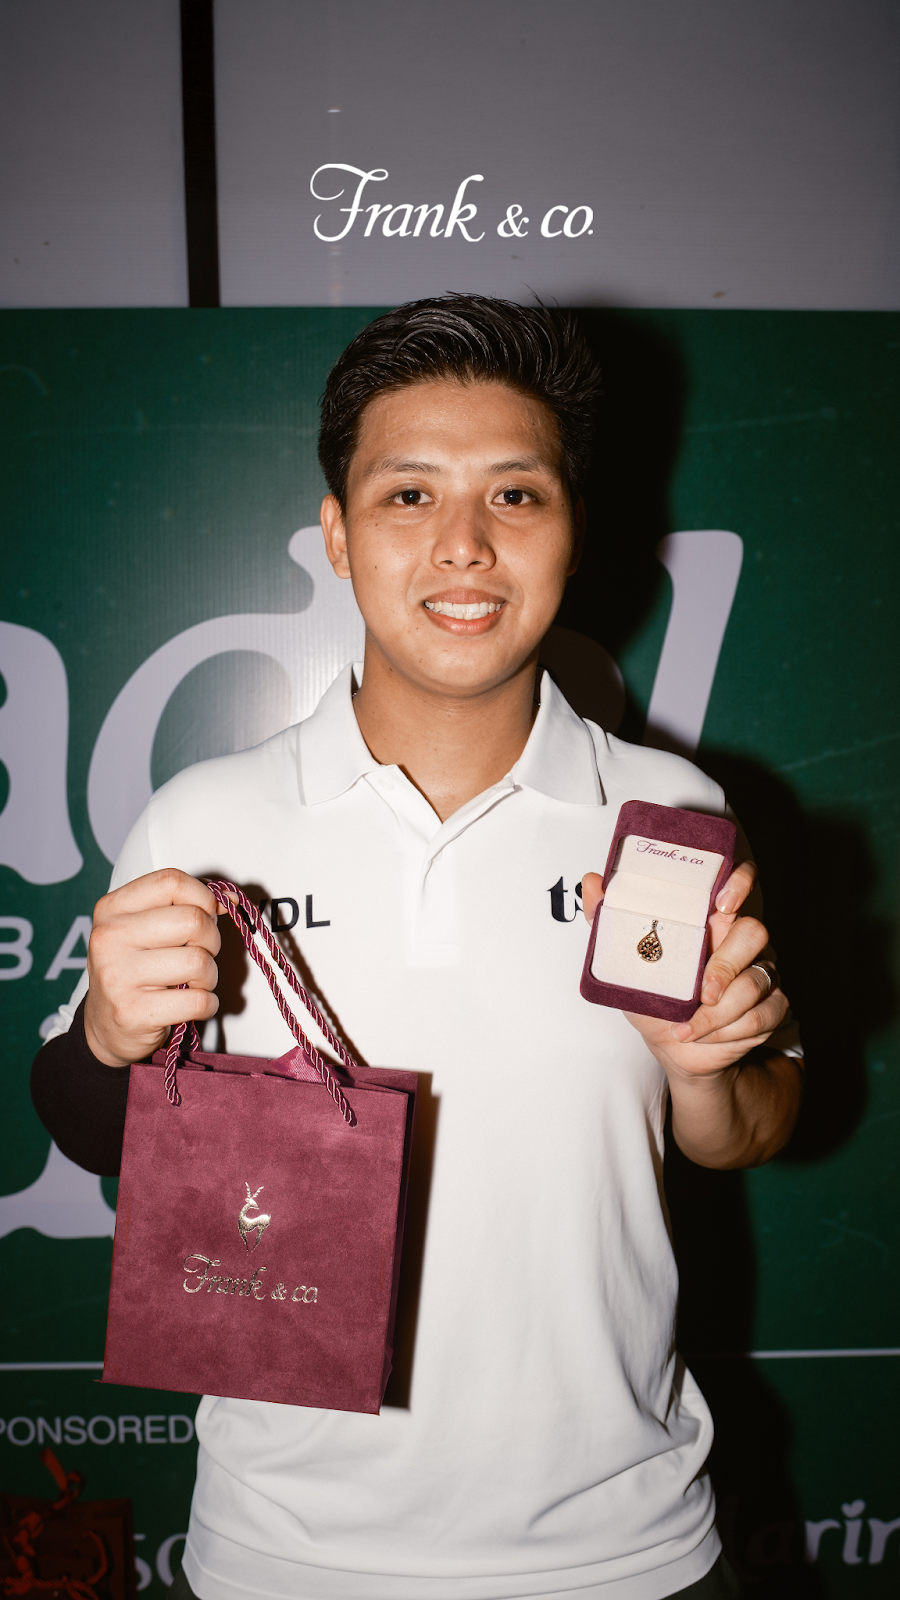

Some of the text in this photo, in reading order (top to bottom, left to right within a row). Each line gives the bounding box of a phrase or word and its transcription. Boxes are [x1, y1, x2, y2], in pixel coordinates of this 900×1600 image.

[636, 840, 680, 860] Frank
[183, 1254, 267, 1300] Frank
[271, 1283, 287, 1300] &
